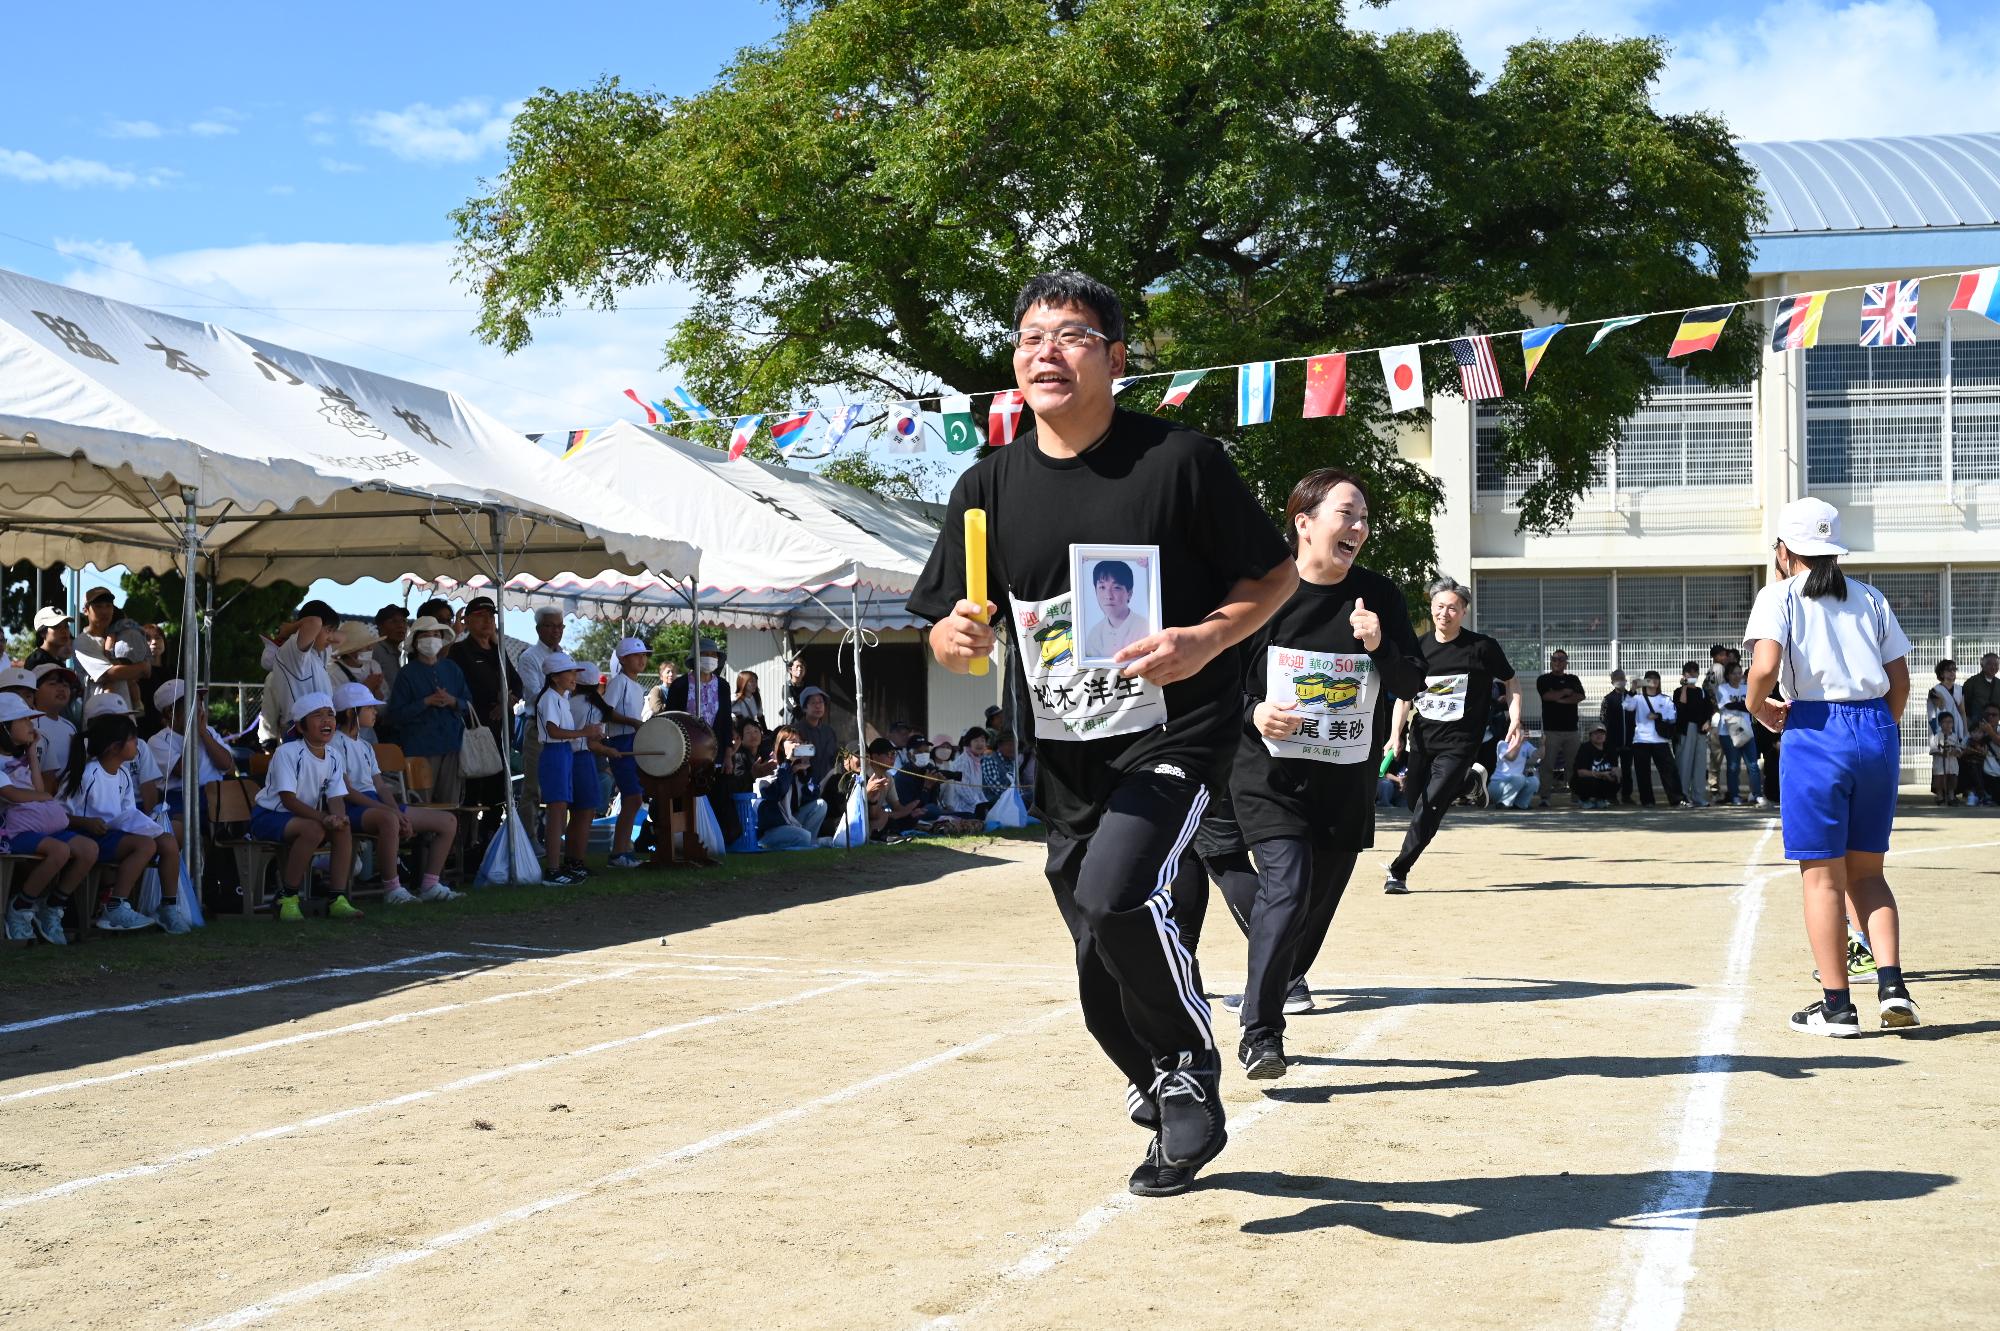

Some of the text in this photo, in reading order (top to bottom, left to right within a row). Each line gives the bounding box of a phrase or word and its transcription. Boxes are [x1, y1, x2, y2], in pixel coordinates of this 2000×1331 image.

[1083, 675, 1144, 707] 洋生
[1292, 718, 1365, 741] 尾 美砂
[1302, 745, 1341, 757] 阿久根市
